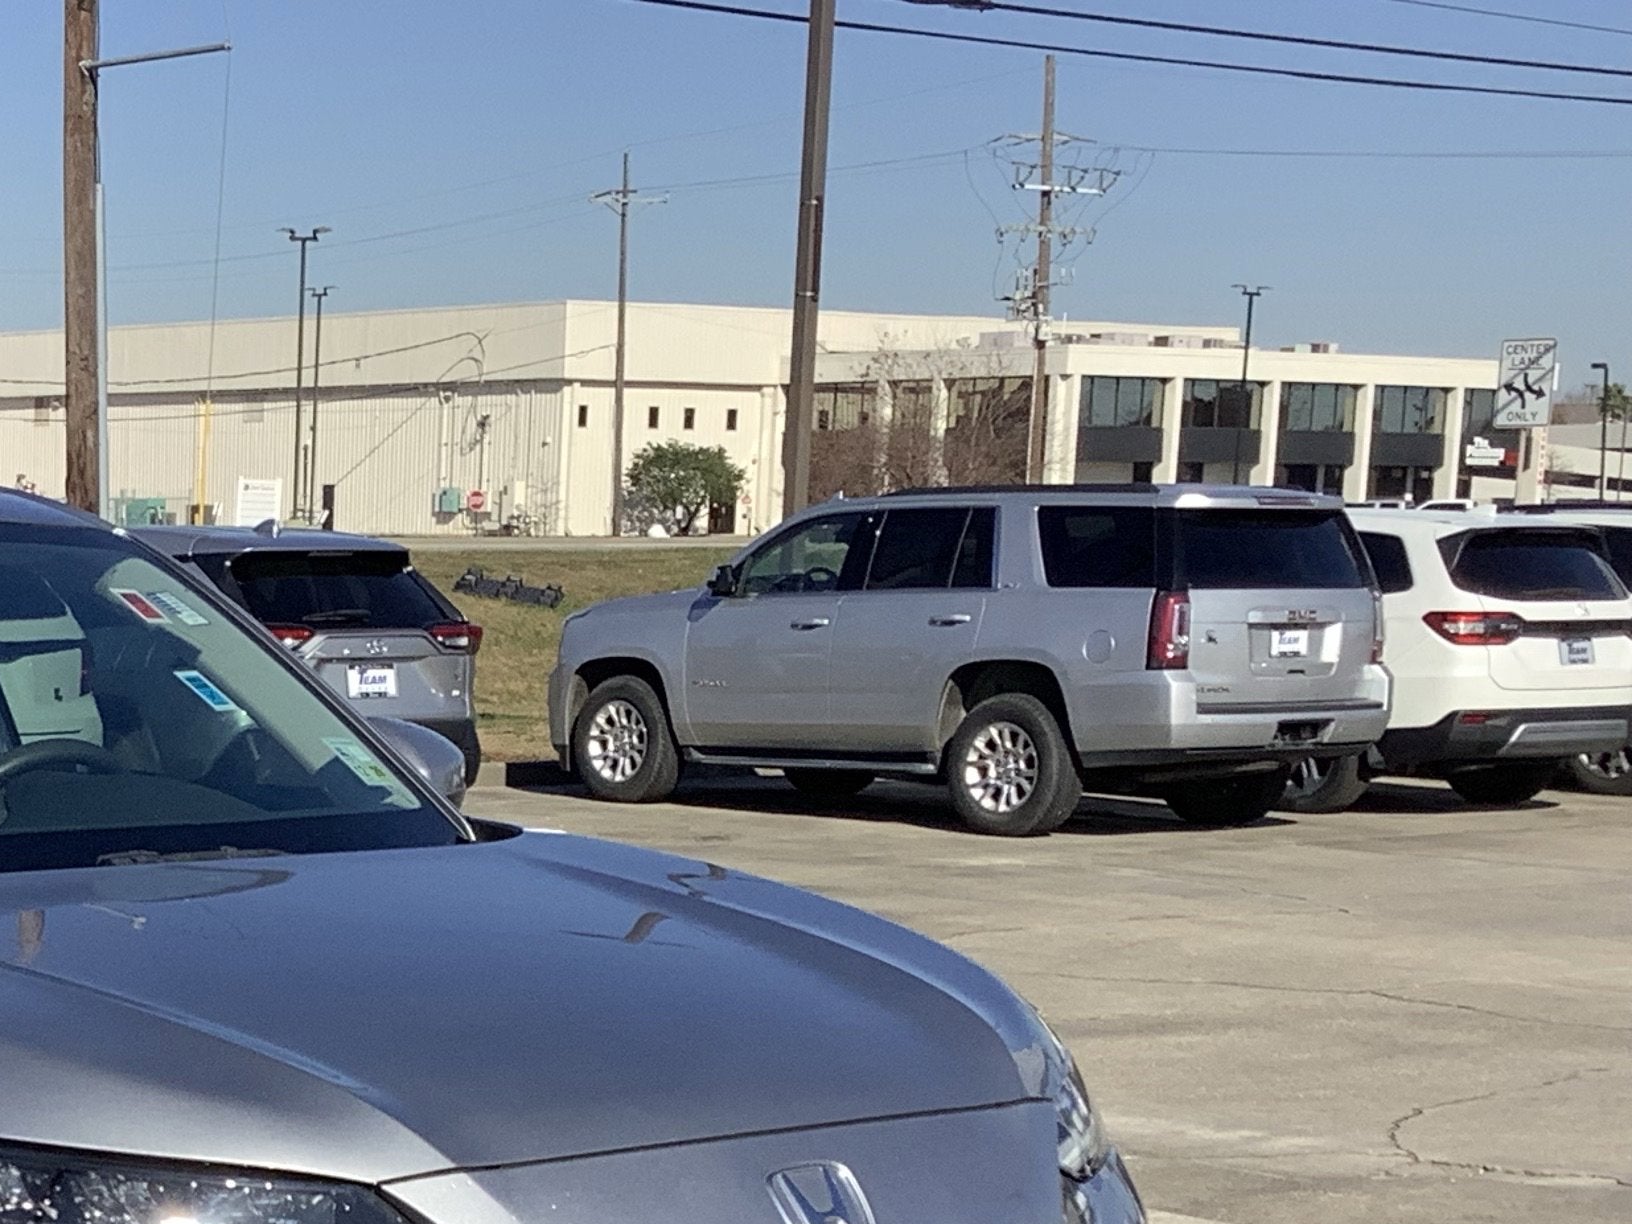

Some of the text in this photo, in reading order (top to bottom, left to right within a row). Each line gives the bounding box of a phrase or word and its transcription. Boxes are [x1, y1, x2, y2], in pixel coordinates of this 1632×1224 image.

[1505, 343, 1553, 355] CENTER
[1511, 356, 1543, 367] LANE
[1506, 411, 1539, 422] ONLY
[357, 663, 388, 685] TEAM
